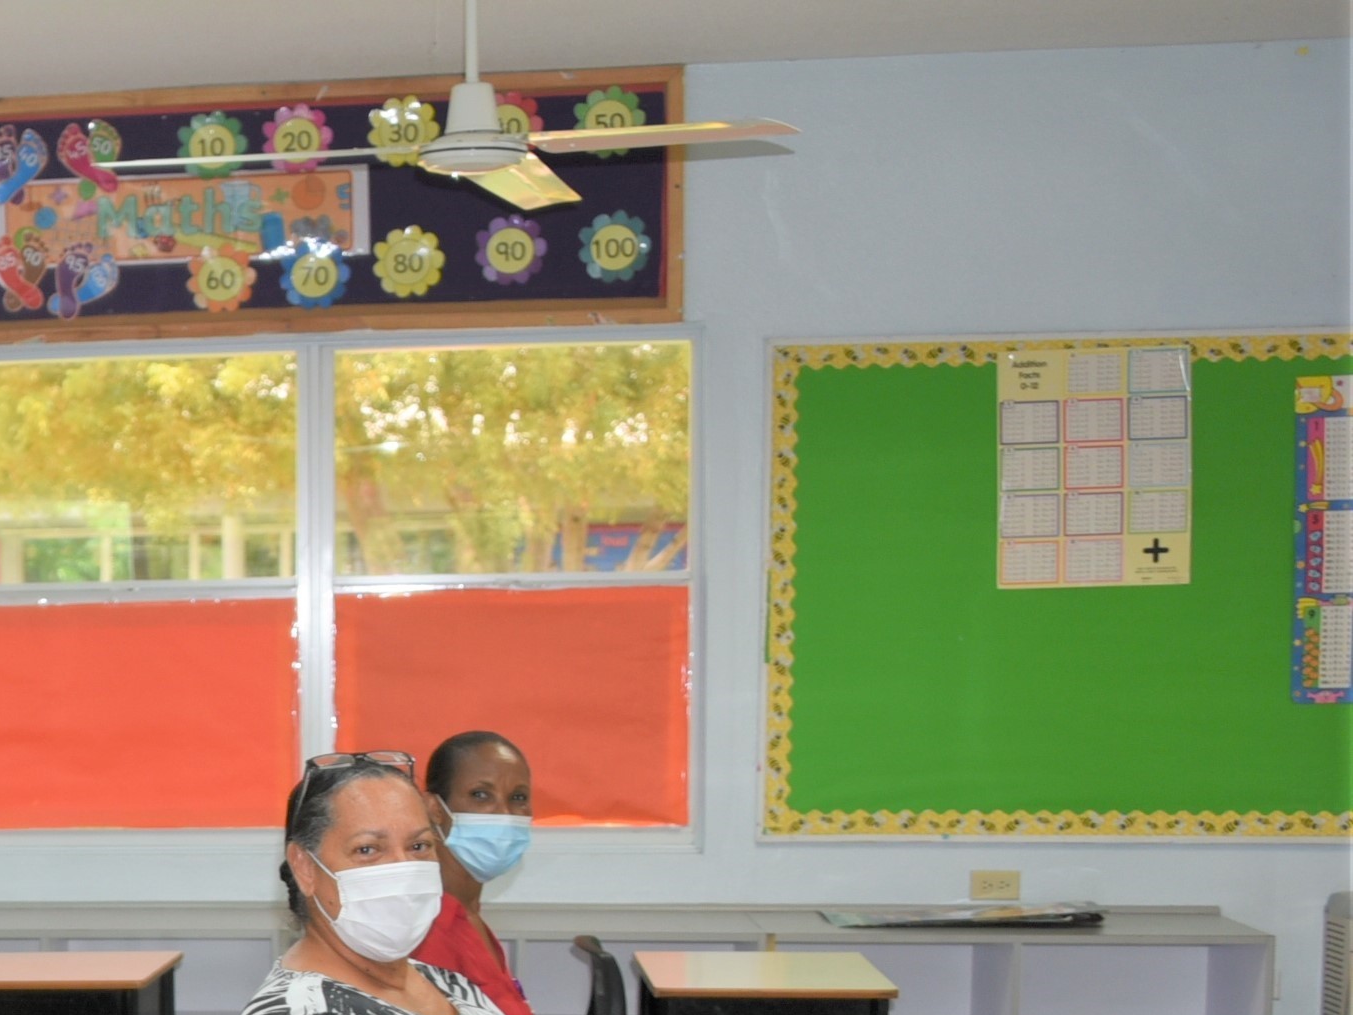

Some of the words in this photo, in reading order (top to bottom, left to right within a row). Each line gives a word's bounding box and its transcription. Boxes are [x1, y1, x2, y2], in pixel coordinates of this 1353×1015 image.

[595, 113, 625, 128] 50
[281, 130, 313, 152] 20
[389, 122, 418, 144] 30
[68, 141, 87, 159] 45
[92, 138, 112, 154] 50
[198, 137, 225, 156] 10
[19, 148, 37, 167] 40
[97, 187, 263, 240] Maths
[23, 247, 41, 266] 90
[495, 241, 526, 261] 90
[593, 238, 635, 259] 100
[65, 255, 86, 273] 95
[393, 253, 423, 273] 80
[206, 269, 235, 290] 60
[300, 266, 329, 286] 70
[1012, 360, 1047, 368] Addition
[1019, 371, 1040, 379] Facts
